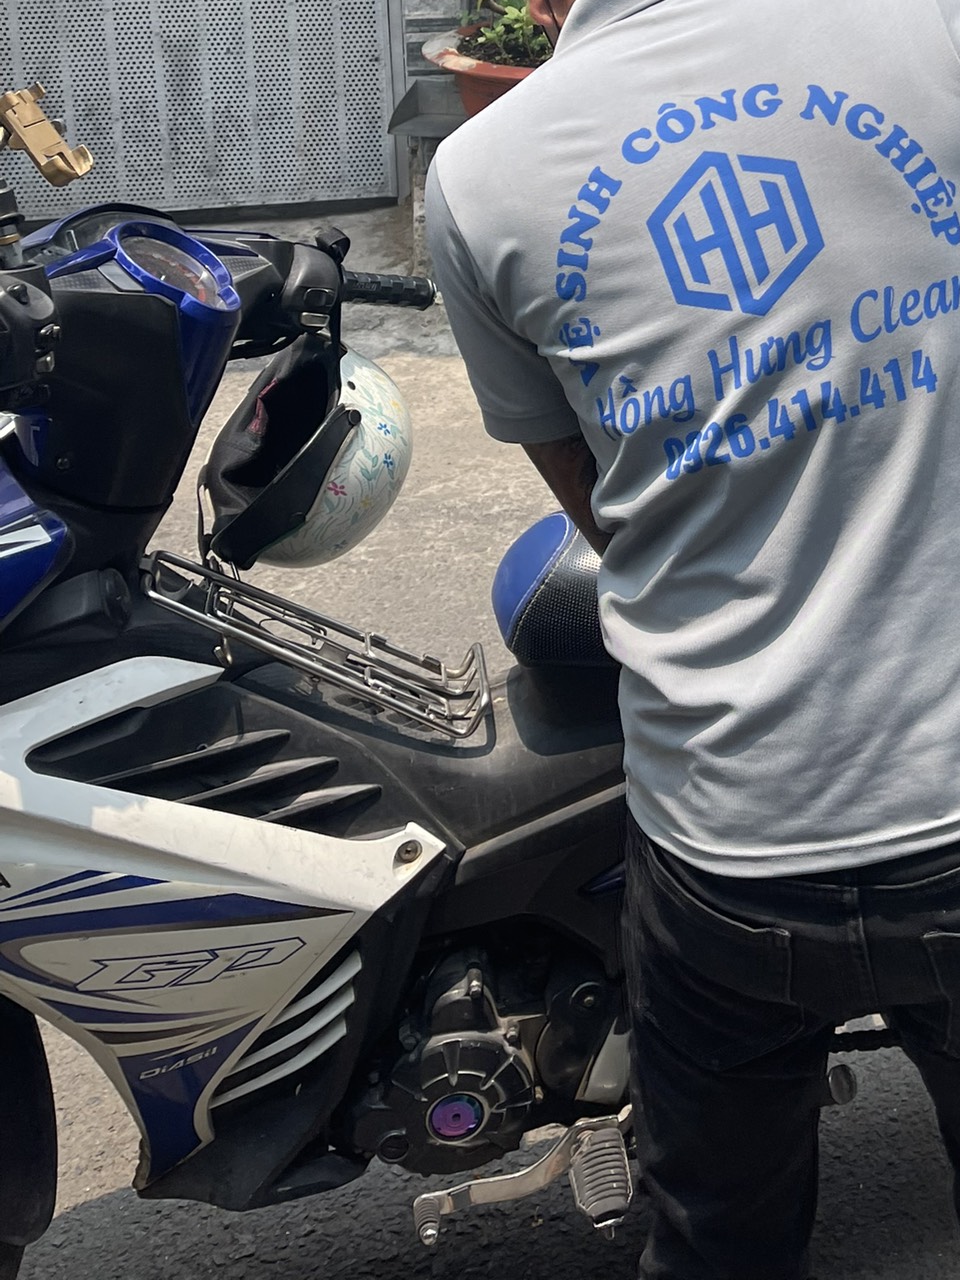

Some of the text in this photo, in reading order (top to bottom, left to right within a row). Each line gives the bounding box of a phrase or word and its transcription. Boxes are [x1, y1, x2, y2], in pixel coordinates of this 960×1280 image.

[555, 166, 623, 303] SINH
[621, 83, 783, 165] CÔNG
[595, 373, 695, 441] Hồng
[708, 319, 835, 402] Hưng
[663, 349, 939, 481] 0926.414.414
